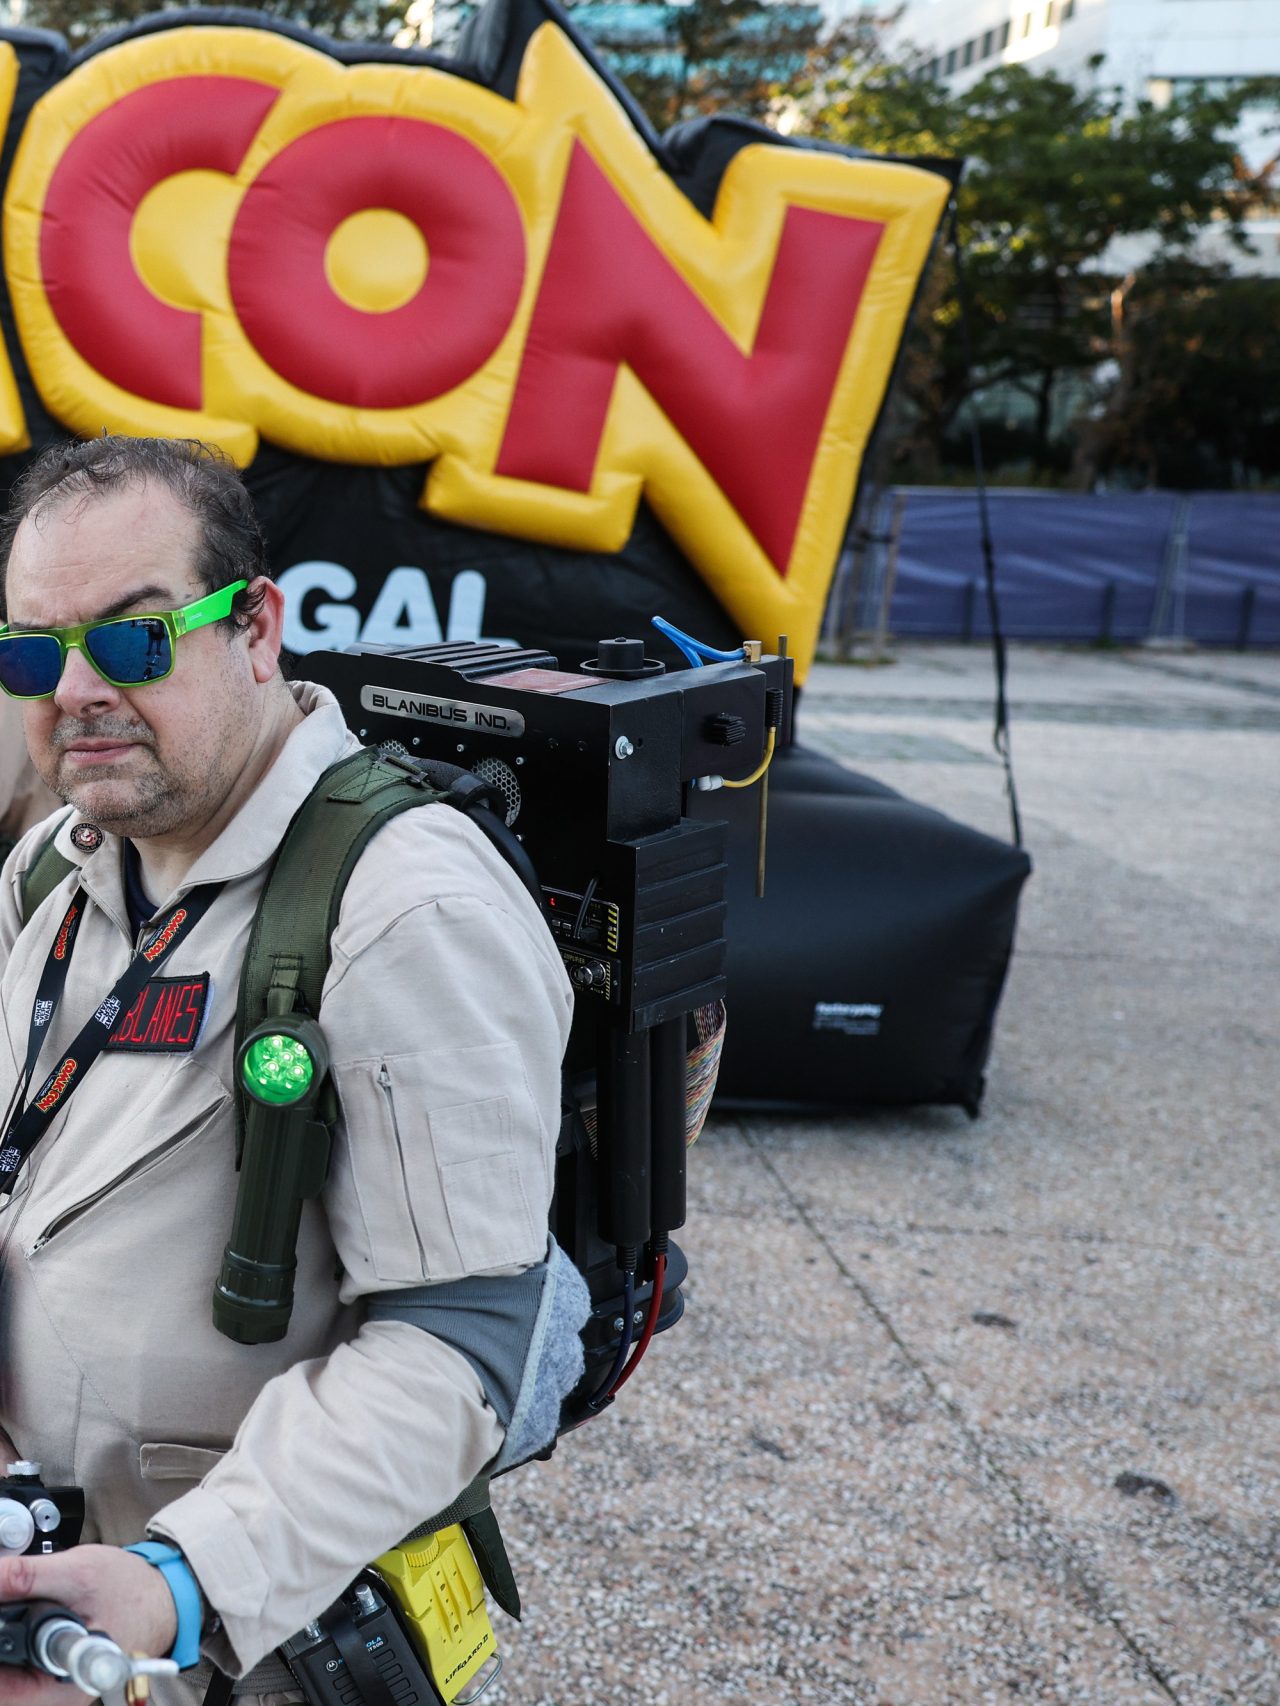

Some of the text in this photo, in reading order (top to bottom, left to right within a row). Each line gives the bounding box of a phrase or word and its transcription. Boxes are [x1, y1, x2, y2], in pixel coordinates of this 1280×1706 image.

[40, 77, 885, 574] CON
[372, 694, 512, 731] BLANIBUS IND.
[160, 908, 187, 943] COMIC
[143, 938, 167, 961] CON
[109, 983, 204, 1043] BLANES
[52, 1059, 77, 1093] COMIC
[35, 1088, 60, 1112] CON
